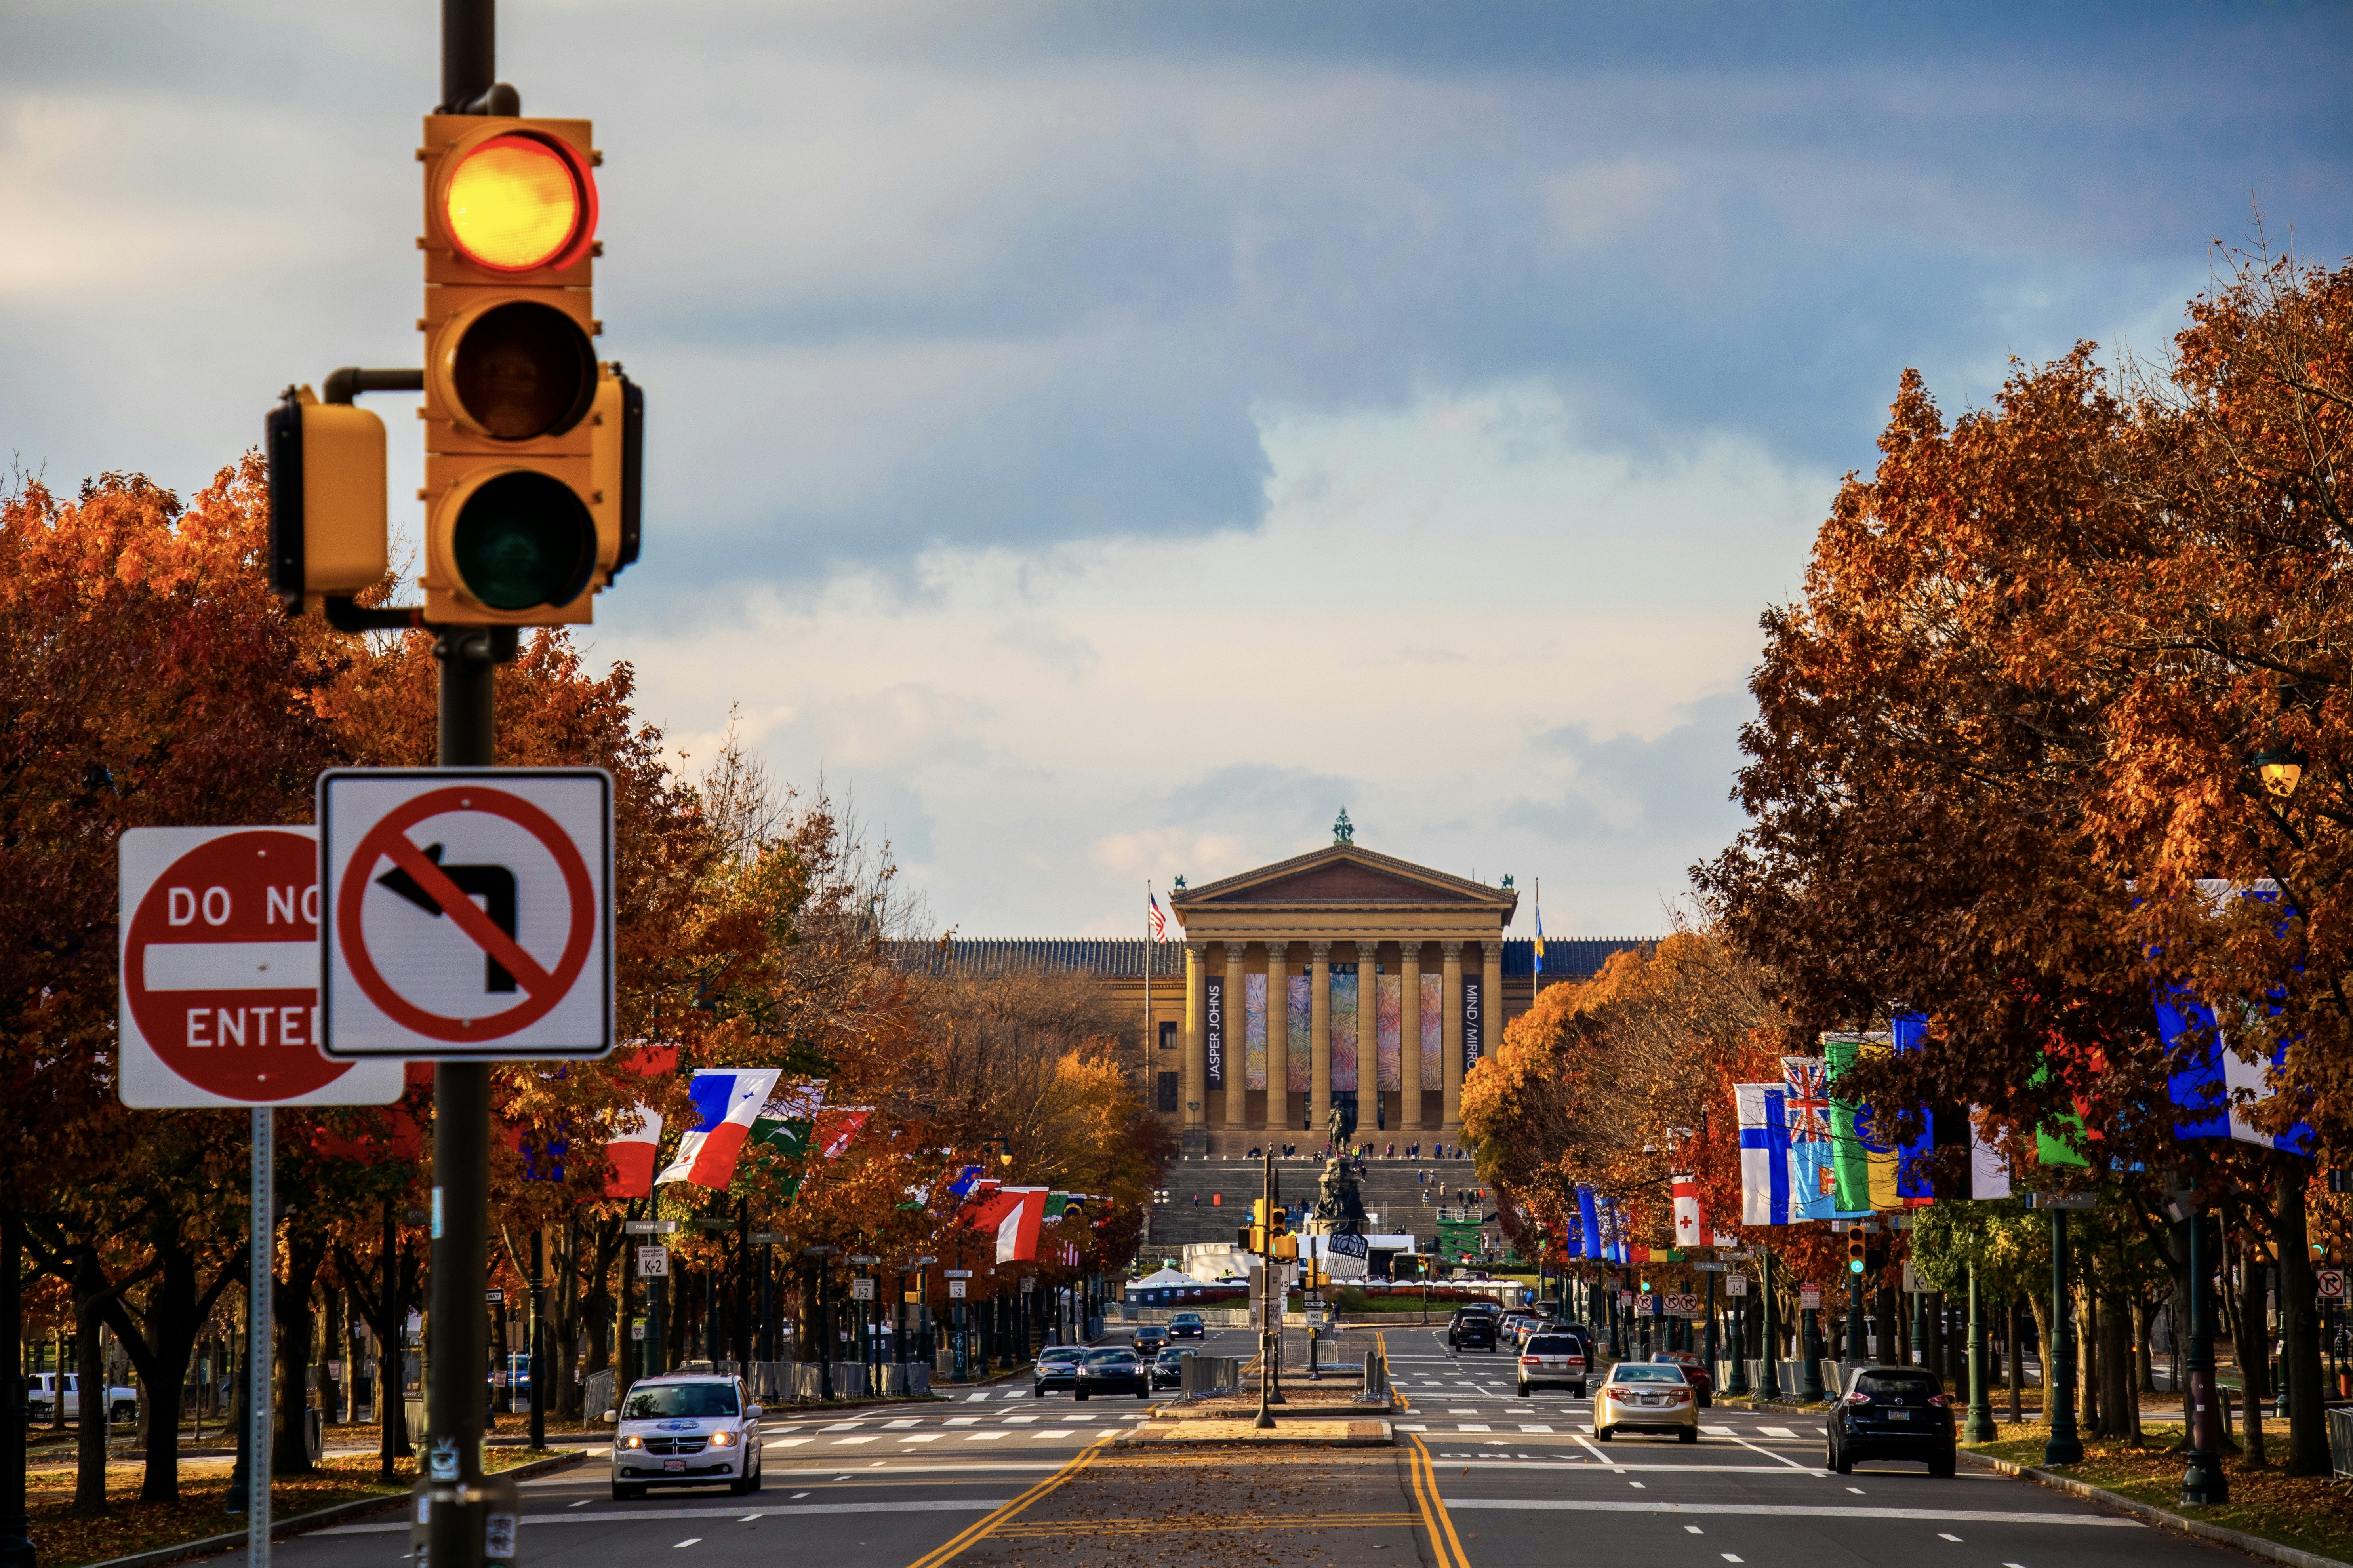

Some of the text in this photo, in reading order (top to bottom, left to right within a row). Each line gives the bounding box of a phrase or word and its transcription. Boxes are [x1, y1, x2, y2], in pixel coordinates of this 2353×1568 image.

[168, 884, 318, 926] DO NO
[1467, 985, 1477, 1020] MIND
[187, 1006, 318, 1048] ENTE
[1209, 986, 1220, 1080] JASPER JOHNS
[1467, 1029, 1478, 1069] MIRRO
[644, 1259, 662, 1273] K-2
[857, 1288, 869, 1298] J-2
[1732, 1284, 1741, 1294] J-1
